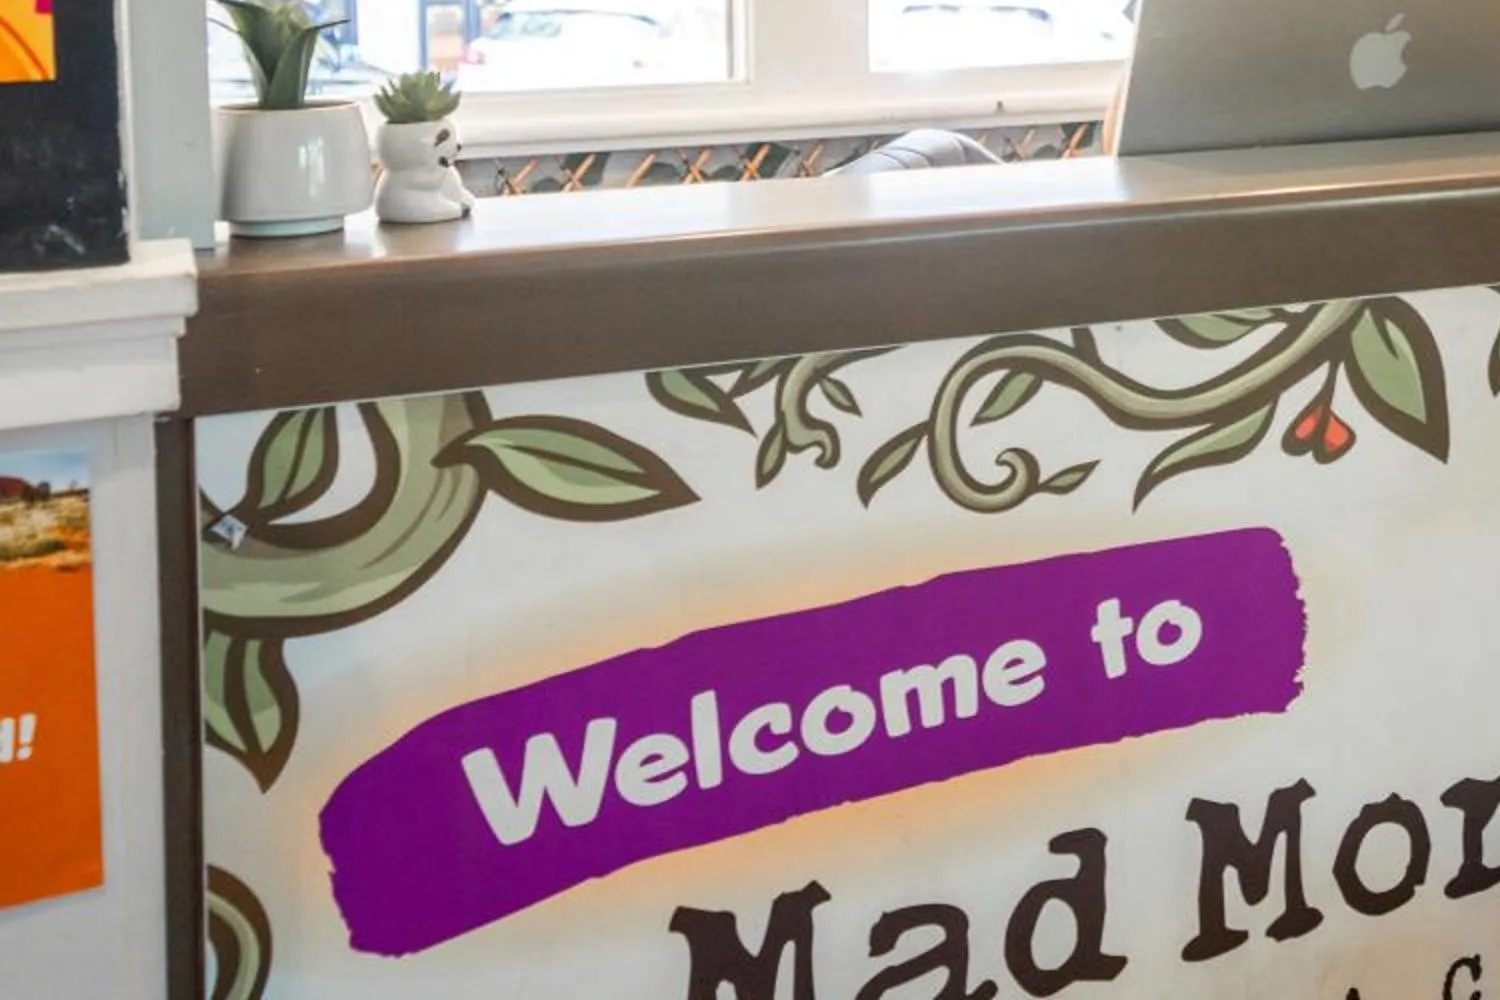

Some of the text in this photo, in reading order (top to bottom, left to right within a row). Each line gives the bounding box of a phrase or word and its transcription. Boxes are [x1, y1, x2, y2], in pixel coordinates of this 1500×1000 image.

[461, 597, 1202, 846] Welcome to
[669, 827, 1128, 1000] Mad
